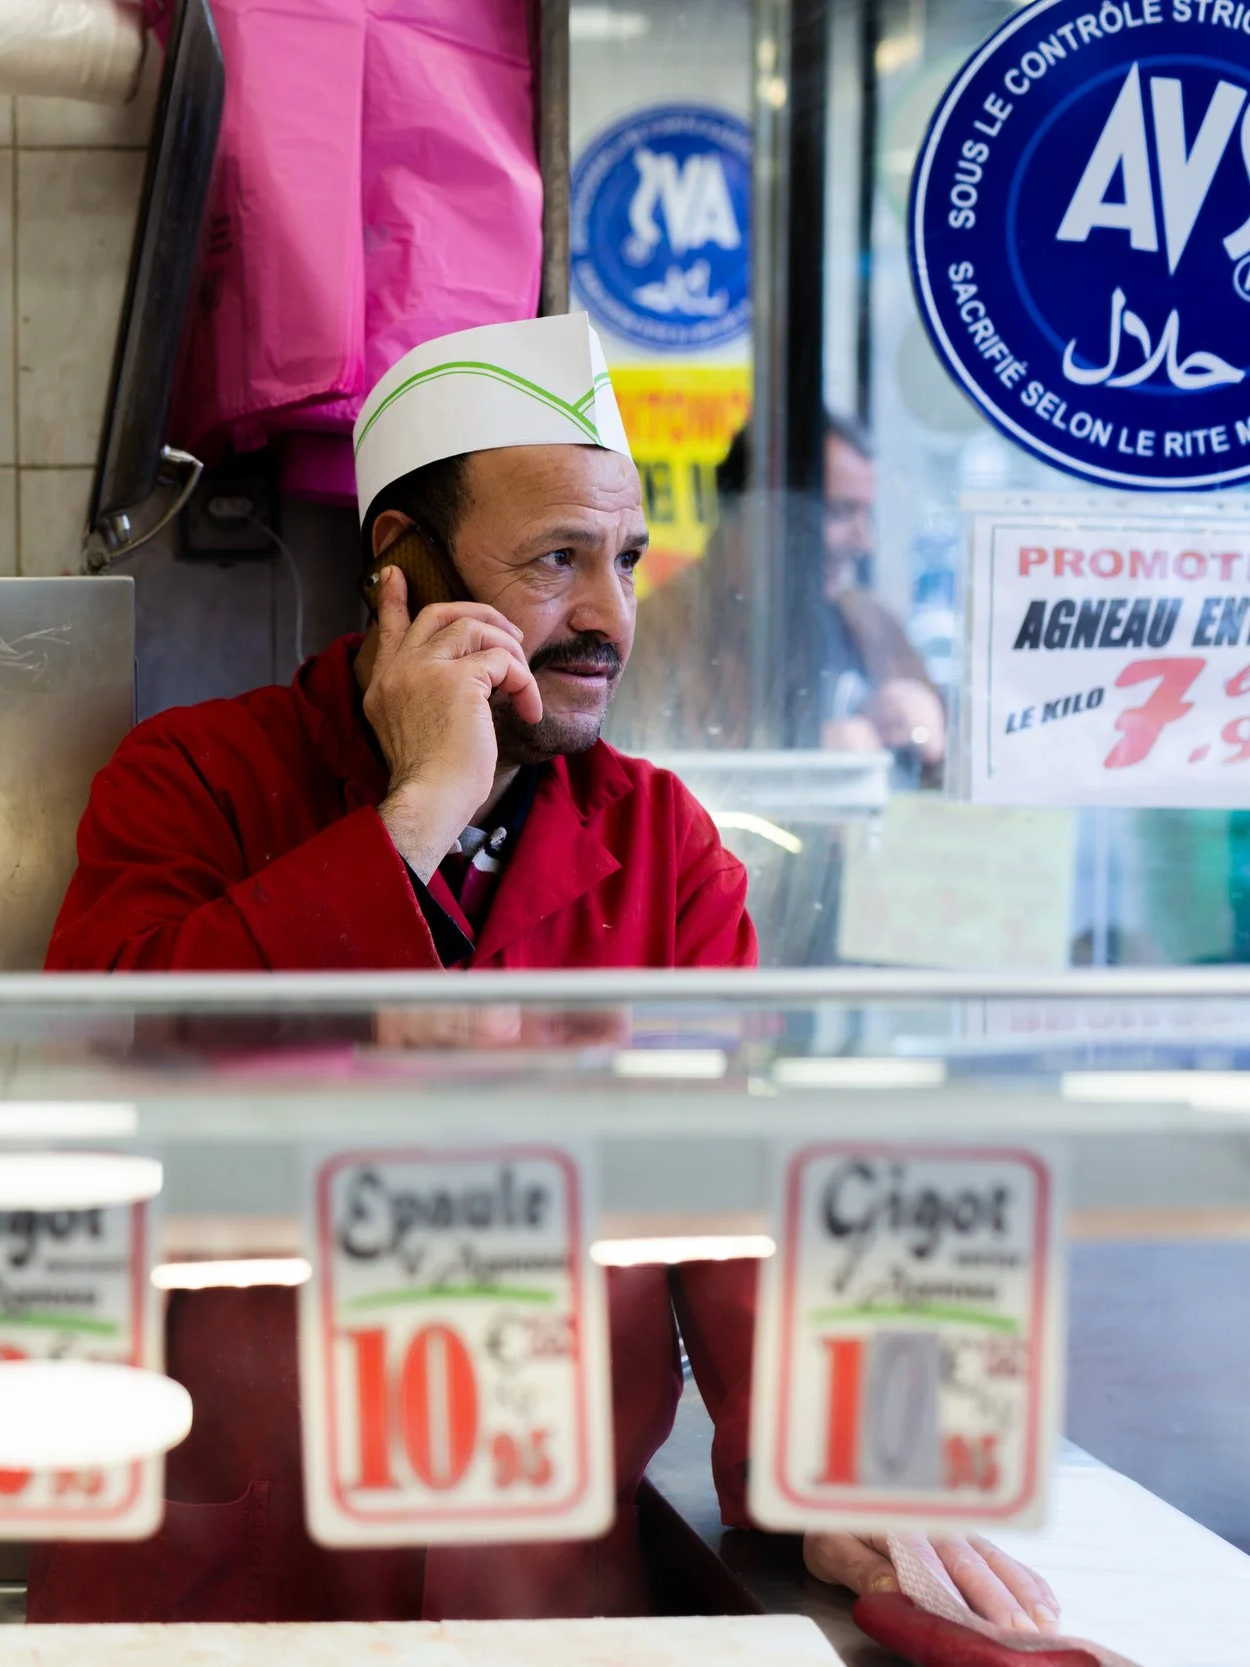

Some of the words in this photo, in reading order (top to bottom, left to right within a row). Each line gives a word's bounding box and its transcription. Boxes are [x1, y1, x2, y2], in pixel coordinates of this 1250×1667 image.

[949, 139, 990, 229] SOUS
[974, 92, 1014, 137] LE
[1004, 0, 1163, 96] CONTRÔLE
[1056, 60, 1250, 277] AV
[948, 261, 1029, 389] SACRIFIÉ
[1020, 381, 1113, 447] SELON
[1118, 427, 1155, 457] LE
[1163, 426, 1230, 457] RITE
[1062, 287, 1246, 390] حلال
[1012, 597, 1183, 651] AGNEAU
[1191, 596, 1250, 647] EN
[1018, 546, 1250, 582] PROMOT
[1005, 705, 1035, 734] LE
[1041, 687, 1105, 724] KILO
[822, 1158, 1009, 1293] Gigot
[349, 1322, 480, 1492] 10
[490, 1428, 556, 1490] 95
